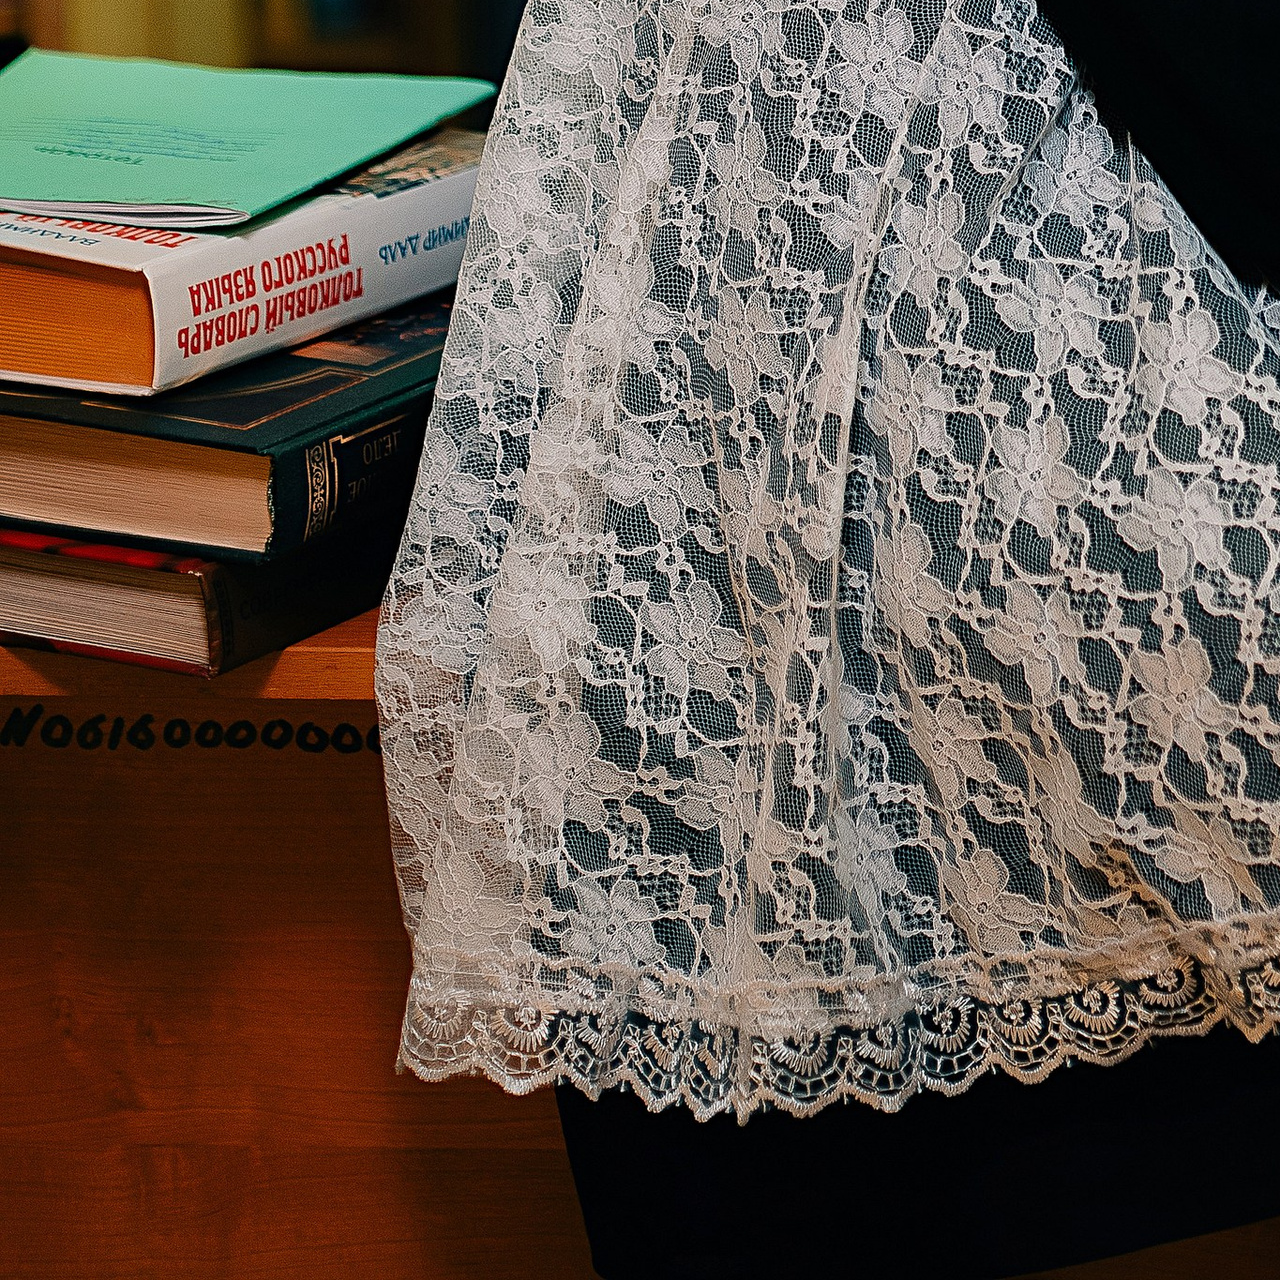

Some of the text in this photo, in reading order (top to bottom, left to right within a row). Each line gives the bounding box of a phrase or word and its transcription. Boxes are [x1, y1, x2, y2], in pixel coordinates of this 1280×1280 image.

[0, 221, 101, 247] ВЛАДИМ
[377, 233, 420, 267] ДАЛЬ
[187, 232, 351, 319] РУССКОГО ЯЗЫКА
[177, 266, 364, 360] ТОЛКОВЫЙ СЛОВАРЬ
